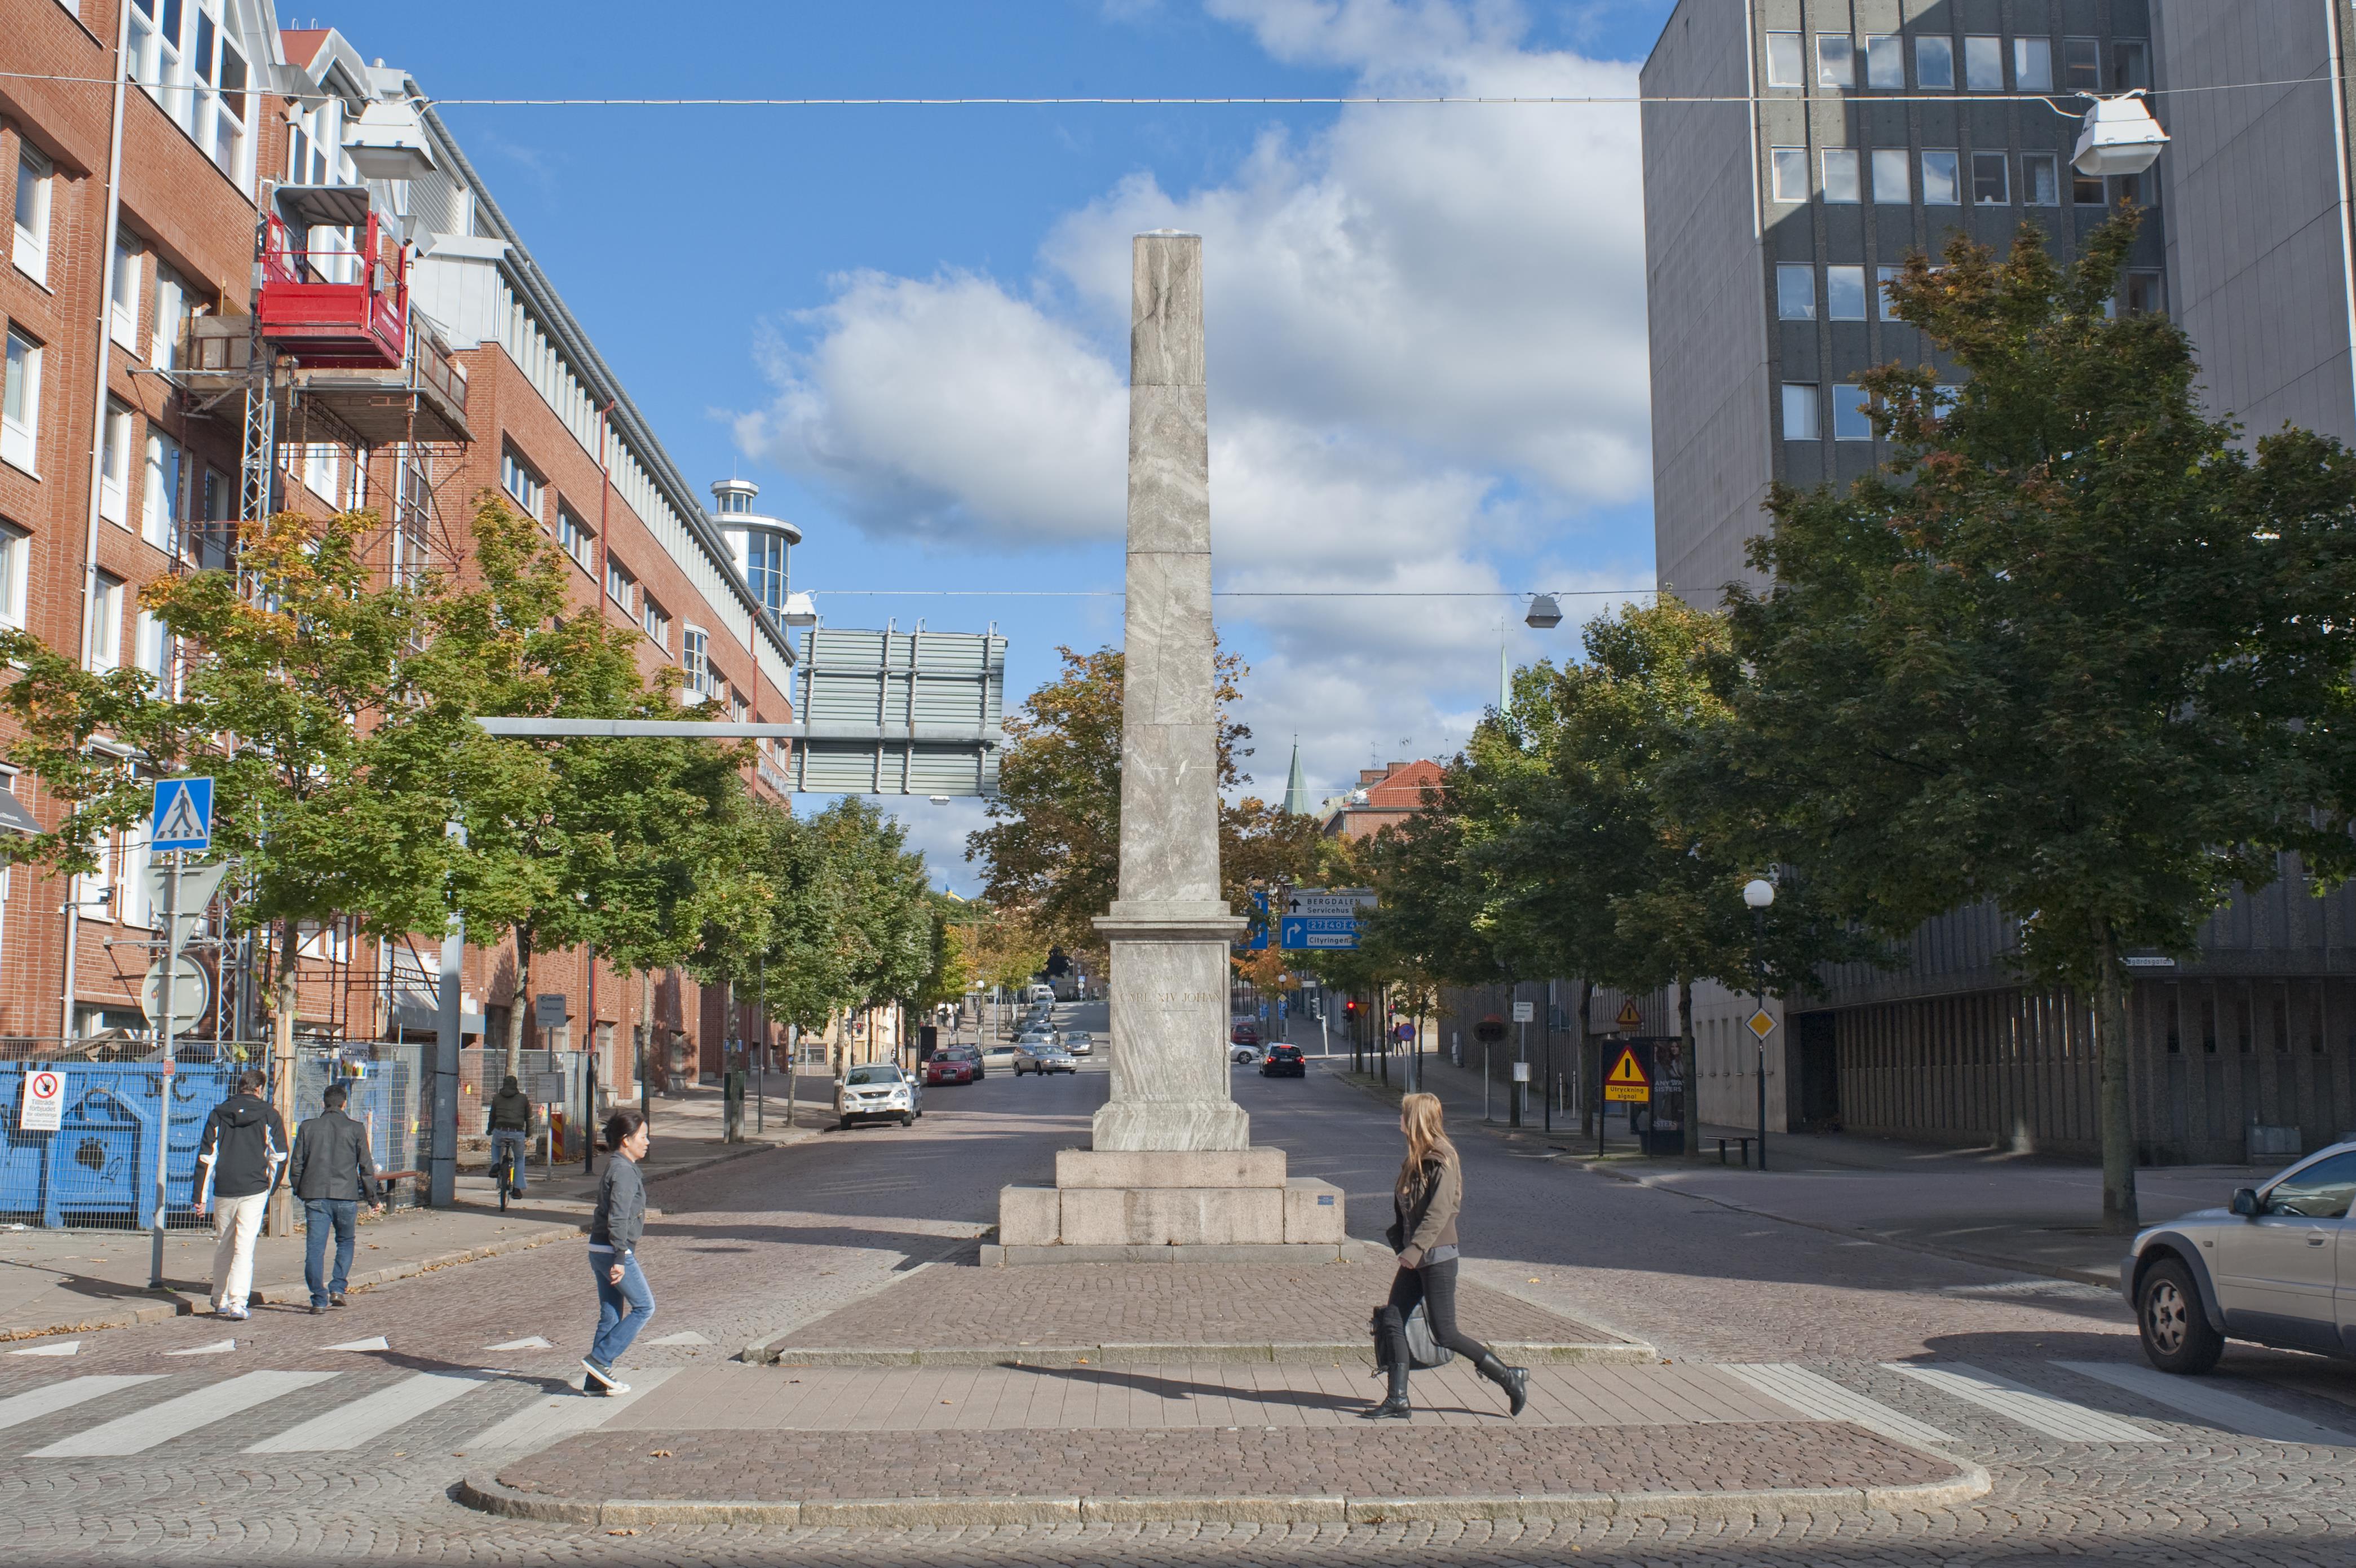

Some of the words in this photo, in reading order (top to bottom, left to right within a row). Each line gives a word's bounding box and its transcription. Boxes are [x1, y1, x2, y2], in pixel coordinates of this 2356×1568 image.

[1120, 992, 1151, 1002] CARL
[1157, 992, 1178, 1002] XIV
[1182, 992, 1222, 1002] JOHAN
